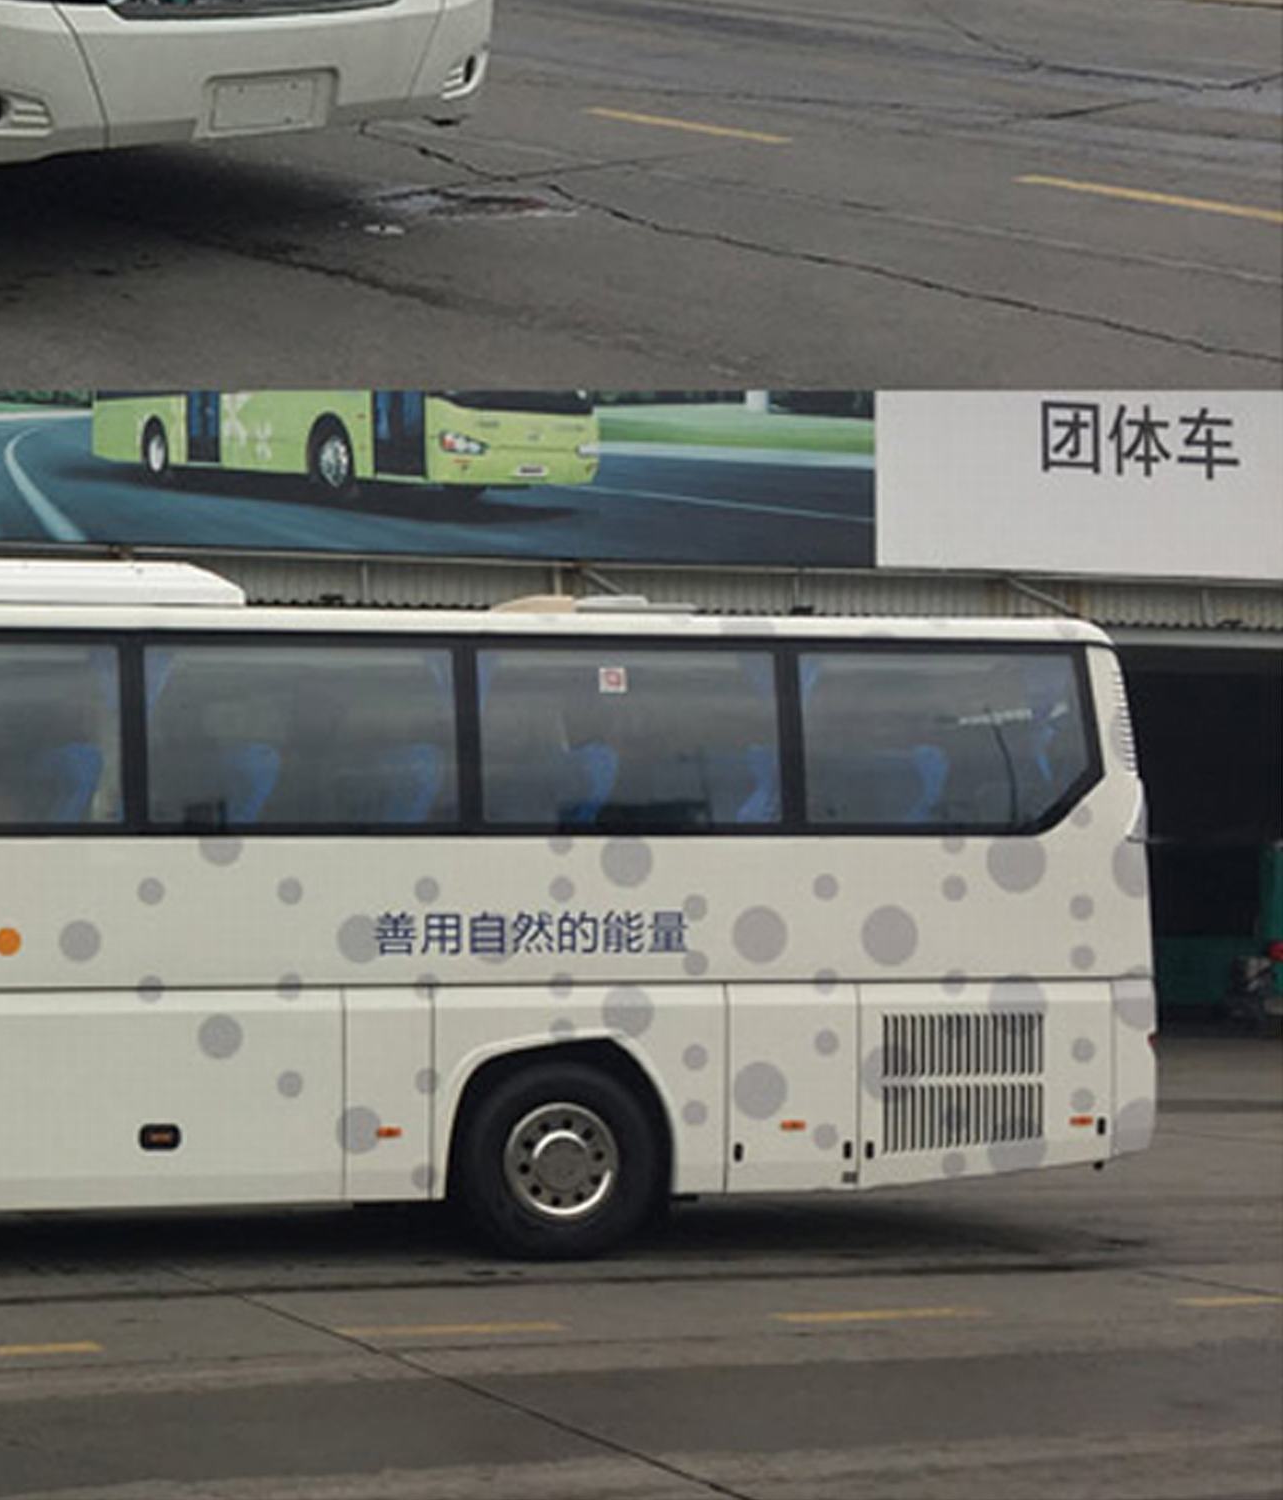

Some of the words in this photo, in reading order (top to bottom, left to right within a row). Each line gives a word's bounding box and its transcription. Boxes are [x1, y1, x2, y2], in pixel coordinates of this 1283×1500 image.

[1041, 400, 1241, 480] 团体车
[375, 910, 688, 956] 善用自然的能量
